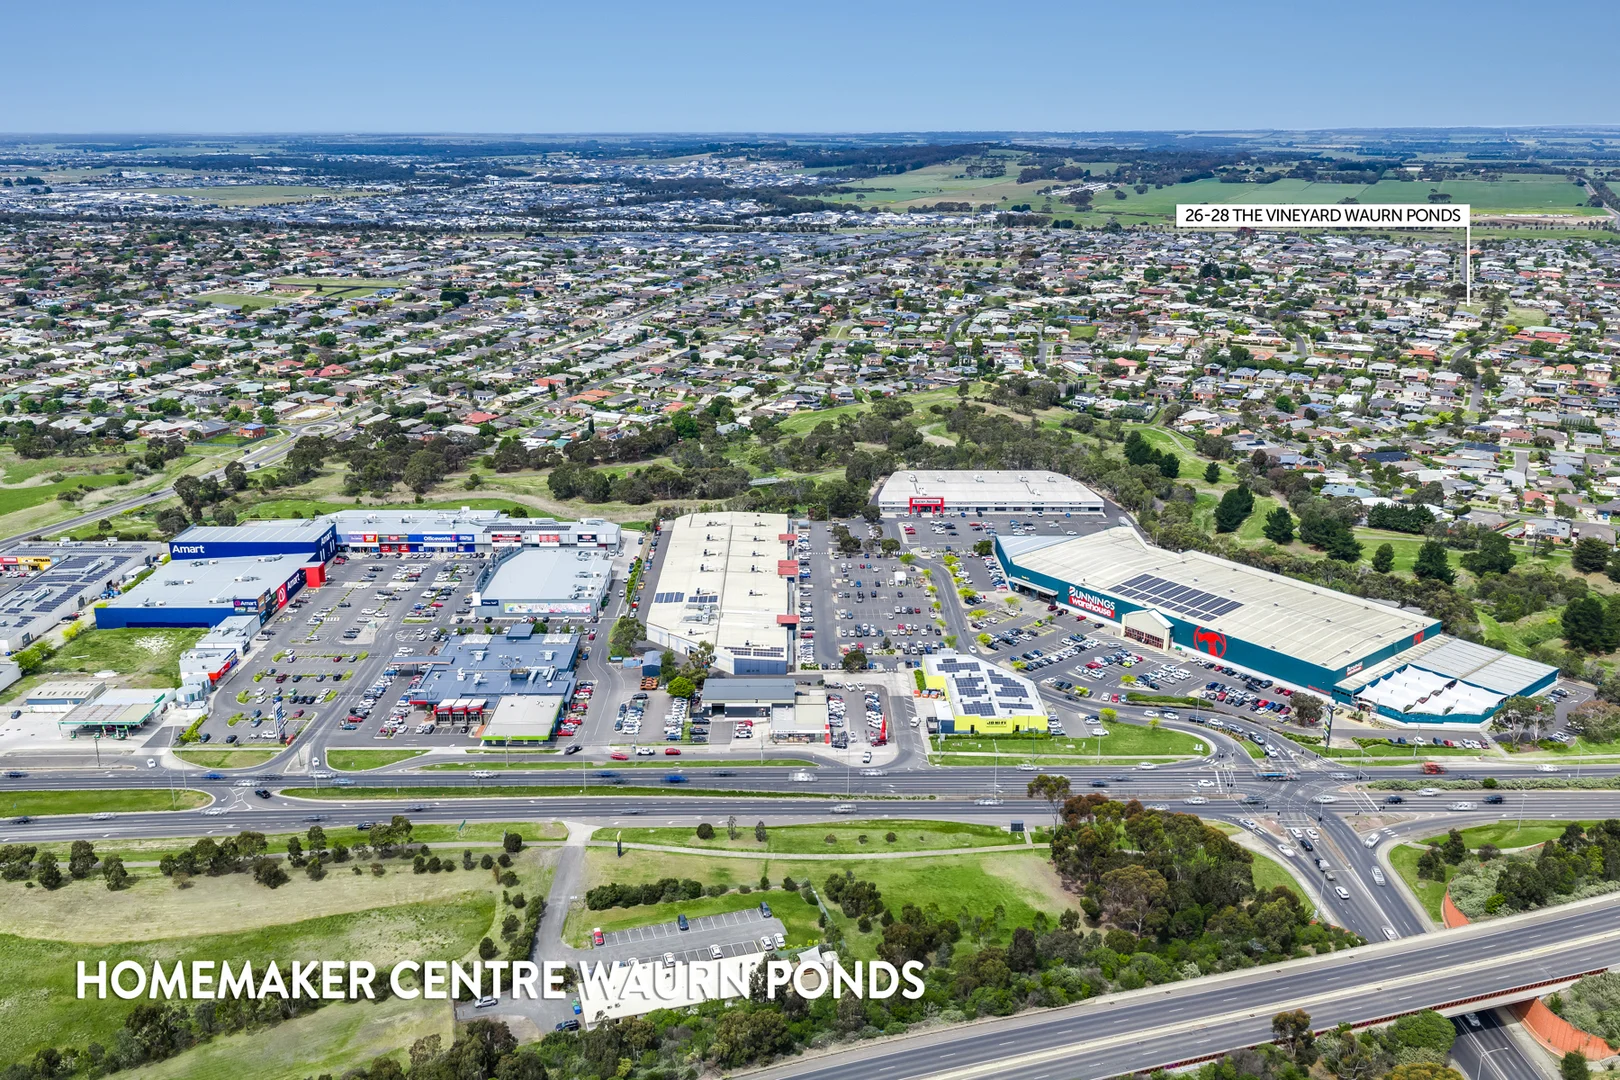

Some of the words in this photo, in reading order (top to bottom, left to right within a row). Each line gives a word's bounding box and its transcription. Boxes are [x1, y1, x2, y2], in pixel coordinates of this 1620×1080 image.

[172, 545, 205, 554] Amart
[287, 573, 301, 591] Amart
[1068, 585, 1116, 611] BUNNINGS
[1071, 597, 1112, 617] warehouse
